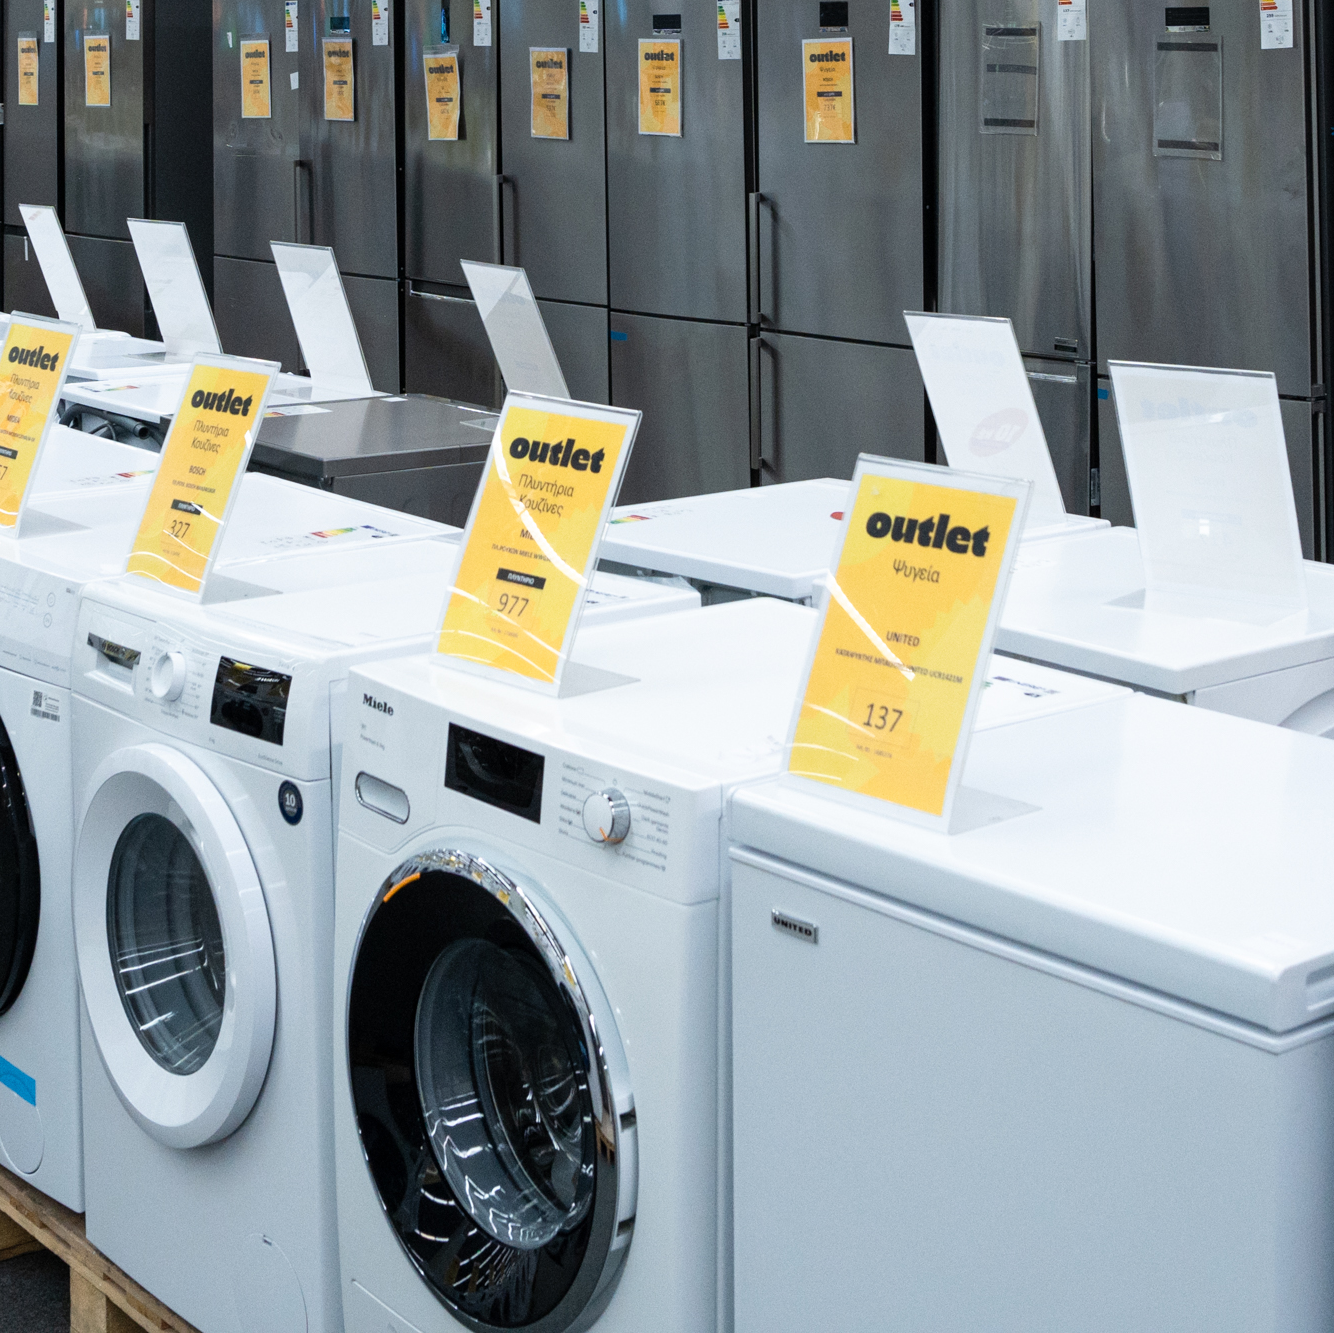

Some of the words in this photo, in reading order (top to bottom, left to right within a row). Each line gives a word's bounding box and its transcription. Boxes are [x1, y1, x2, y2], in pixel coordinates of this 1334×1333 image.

[245, 49, 266, 59] outlet
[327, 48, 350, 58] outlet
[644, 49, 675, 62] outlet
[809, 50, 846, 63] outlet
[428, 64, 454, 75] outlet
[536, 58, 563, 70] outlet
[8, 345, 60, 372] outlet
[10, 373, 40, 390] Πλυντήρια
[8, 389, 33, 405] Κουζίνες
[191, 388, 253, 417] outlet
[193, 420, 230, 438] Πλυντήρια
[191, 437, 221, 454] Κουζίνες
[509, 437, 605, 474] outlet
[188, 465, 206, 476] BOSCH
[518, 474, 575, 497] Πλυντήρια
[518, 494, 564, 517] Κουζίνες
[169, 519, 191, 539] 327
[865, 511, 991, 558] outlet
[892, 559, 940, 583] Ψυγεία
[496, 593, 529, 618] 977
[886, 631, 920, 647] UNITED
[362, 693, 394, 716] Miele
[863, 702, 903, 732] 137
[285, 793, 296, 807] 10
[774, 916, 812, 936] UNITED
